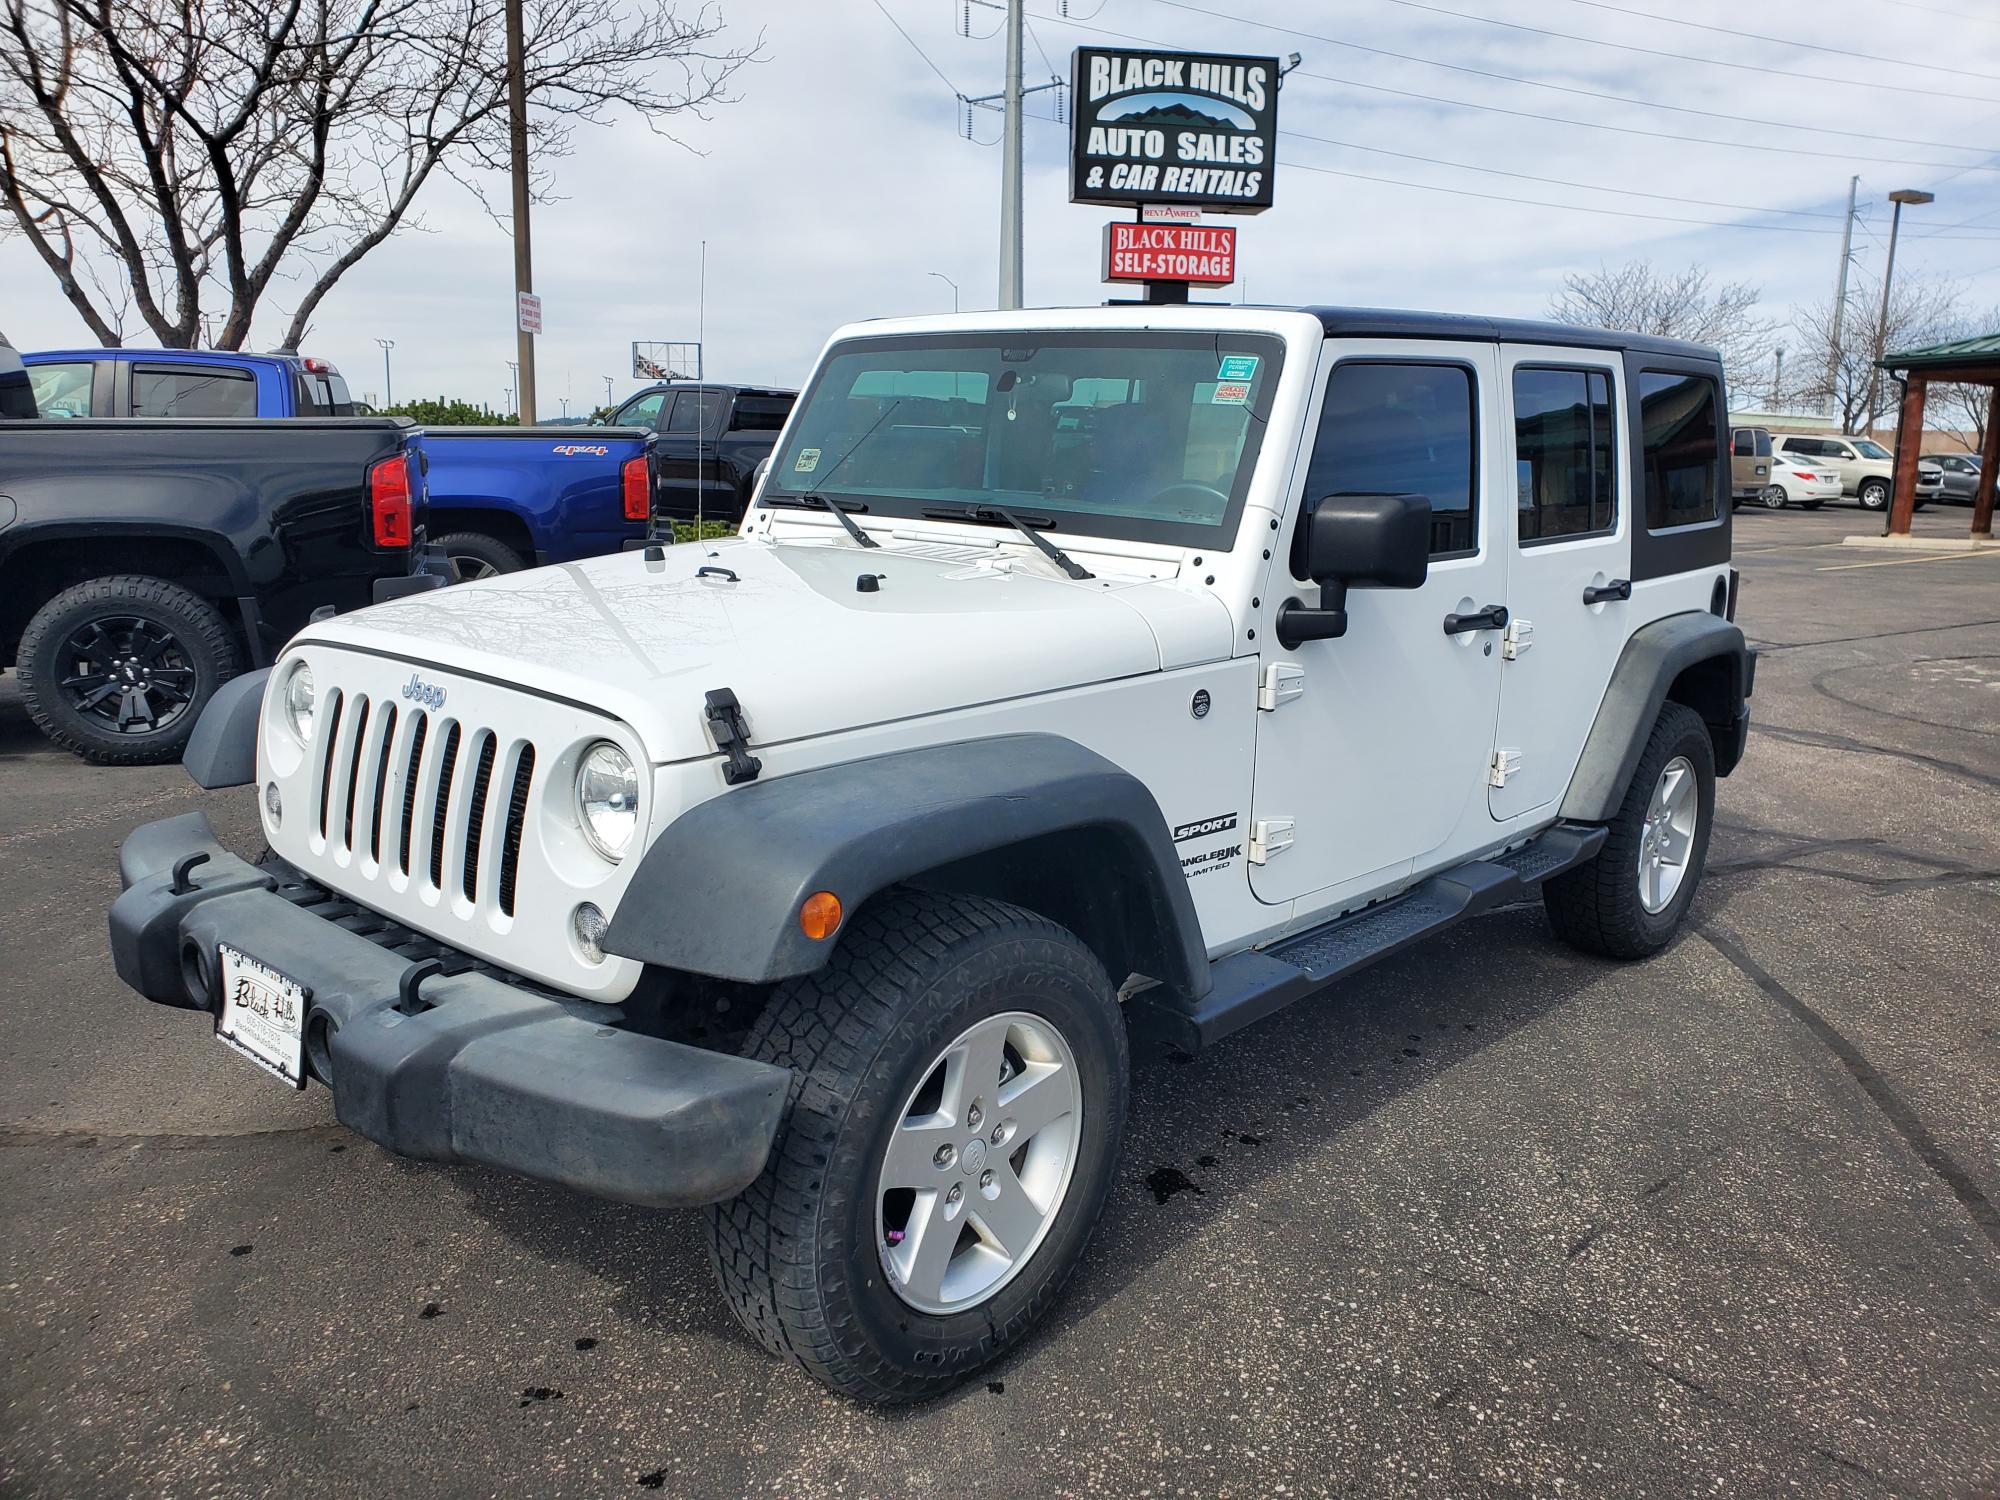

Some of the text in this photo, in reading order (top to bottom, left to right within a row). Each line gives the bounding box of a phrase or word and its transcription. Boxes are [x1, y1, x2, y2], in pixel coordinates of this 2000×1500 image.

[1090, 56, 1267, 112] BLACK HILLS
[1087, 127, 1264, 165] AUTO SALES
[1086, 163, 1262, 198] & CAR RENTALS
[1116, 228, 1231, 255] BLACK HILLS
[1114, 252, 1230, 277] SELF-STORAGE
[402, 673, 447, 712] Jeep
[1177, 816, 1236, 837] SPORT
[1181, 844, 1242, 867] ANGLERJK
[1185, 861, 1230, 879] LIMITED
[233, 978, 269, 1020] Black
